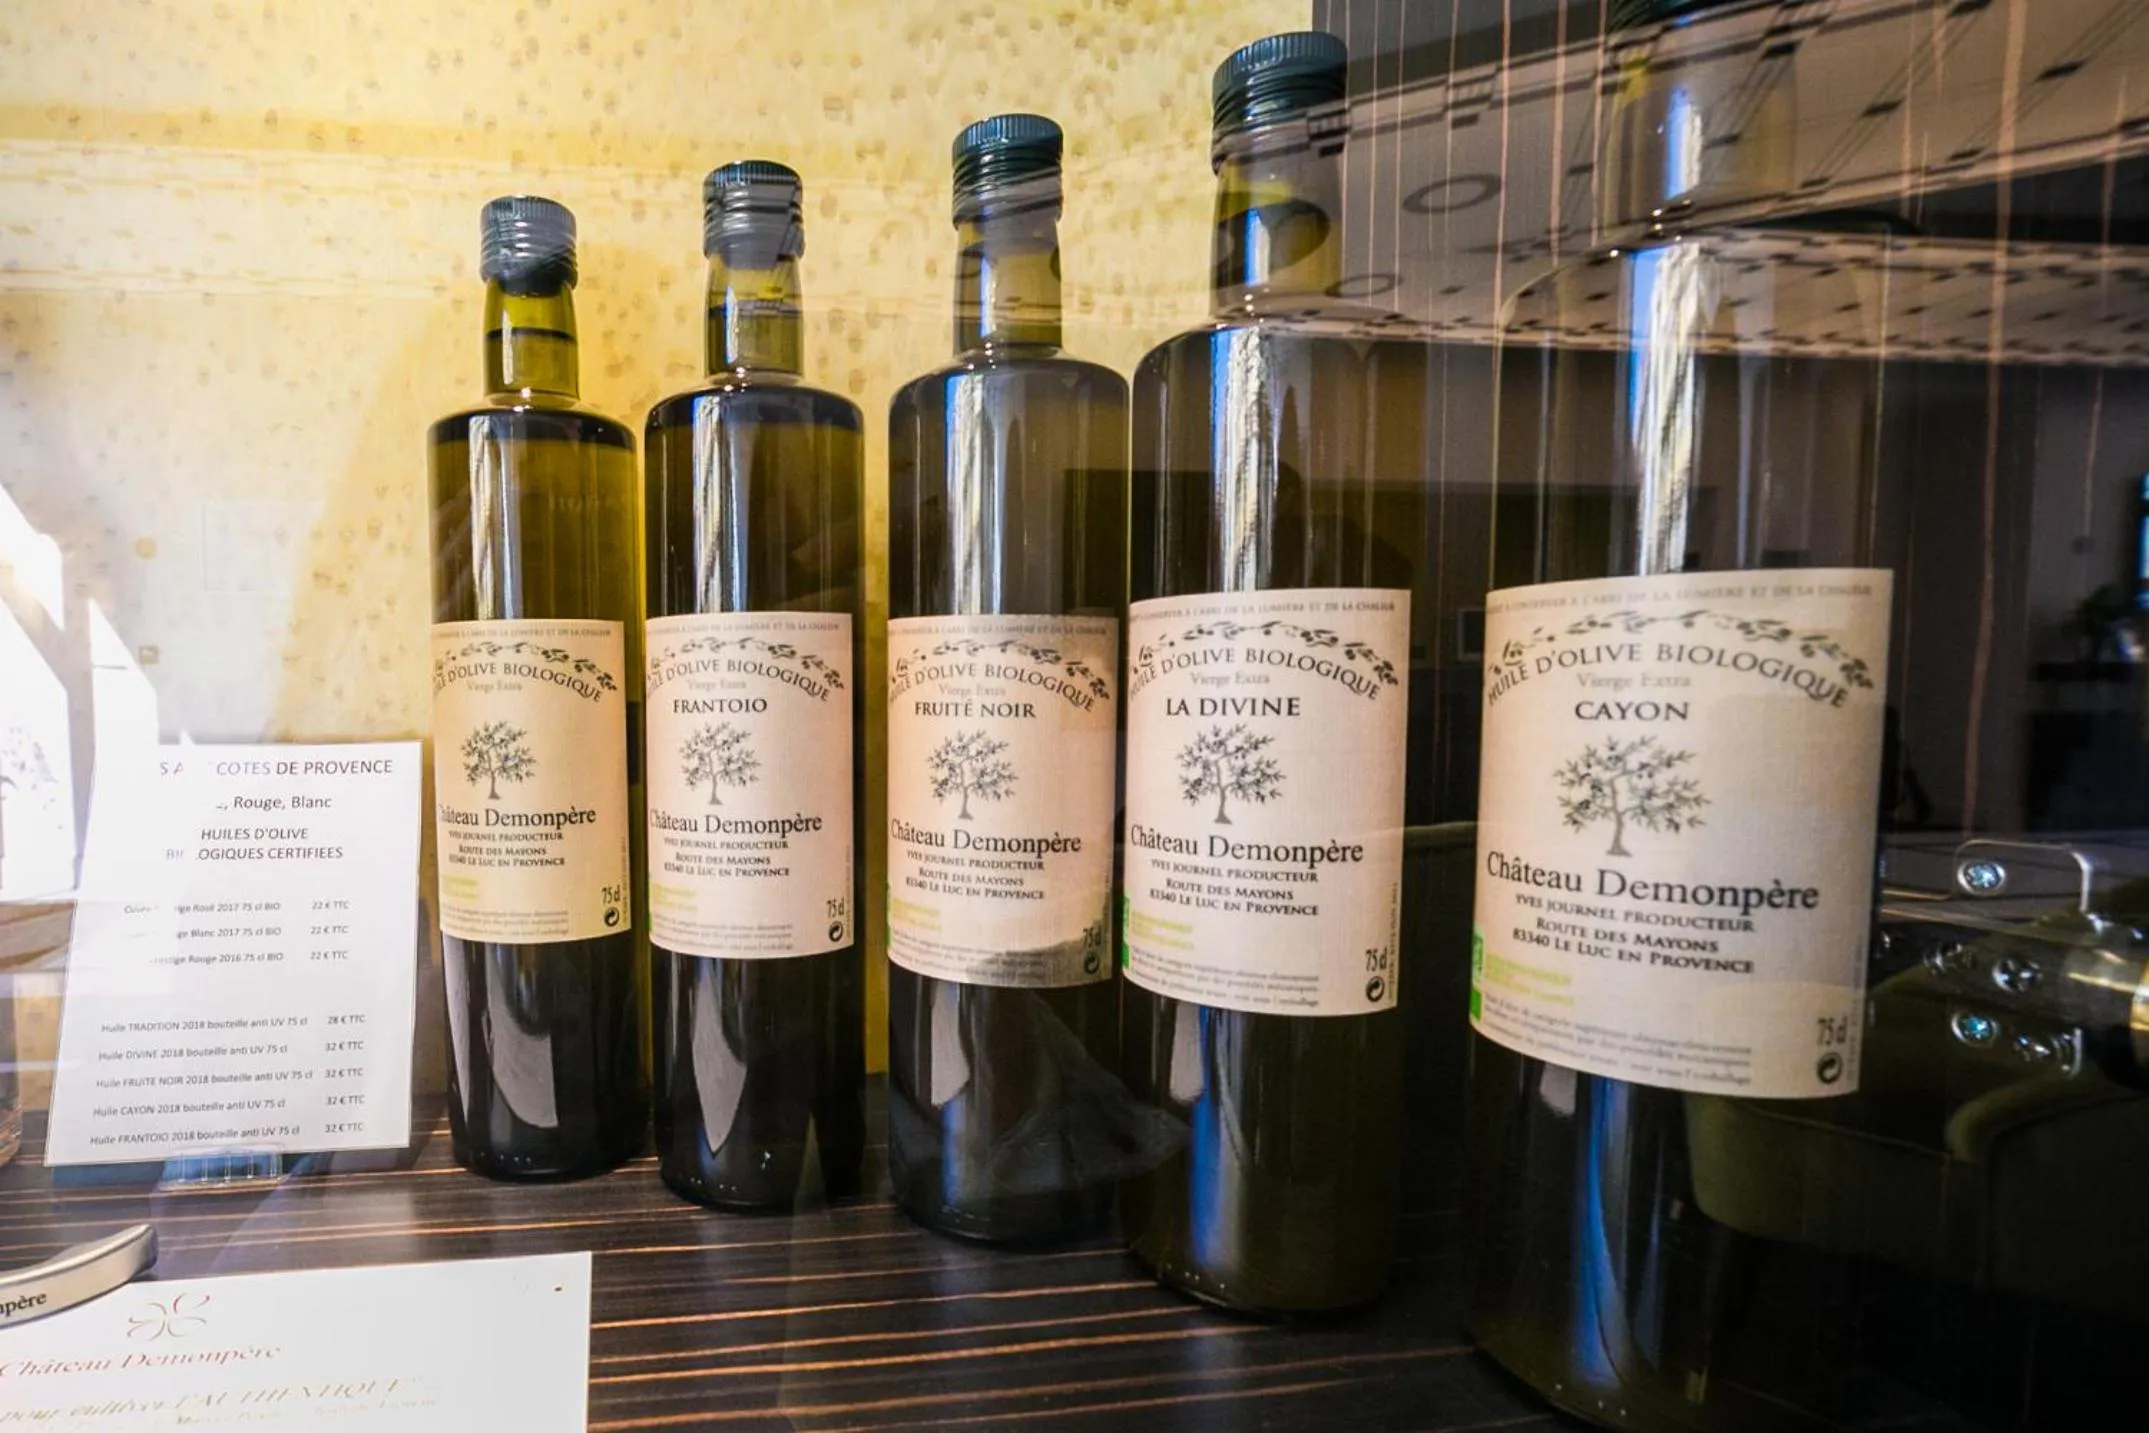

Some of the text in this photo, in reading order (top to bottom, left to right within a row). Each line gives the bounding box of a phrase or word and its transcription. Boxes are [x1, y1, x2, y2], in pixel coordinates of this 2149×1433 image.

[503, 663, 603, 702] BIOLOGIQUE
[727, 659, 831, 702] BIOLOGIQUE
[1161, 648, 1235, 674] D'OLIVE
[1245, 648, 1381, 700] BIOLOGIQUE
[1536, 643, 1642, 675] D'OLIVE
[1656, 643, 1850, 709] BIOLOGIQUE
[984, 663, 1095, 713] BIOLOGIQUE
[673, 698, 768, 714] FRANTOIO
[915, 699, 1036, 718] FRUITÉ NOIR
[1166, 696, 1301, 716] LA DIVINE
[1574, 700, 1690, 721] CAYON
[216, 760, 393, 776] COTES DE PROVENCE
[233, 795, 286, 811] Rouge,
[291, 795, 332, 808] Blanc
[485, 806, 597, 830] Demonpère
[705, 812, 823, 839] Demonpère
[201, 827, 309, 841] HUILES D'OLIVE
[891, 819, 1081, 859] Château Demonpère
[267, 846, 343, 859] CERTIFIEES
[1131, 824, 1364, 869] Château Demonpère
[513, 858, 565, 866] PROVENCE
[727, 856, 771, 865] MAYONS
[968, 858, 1045, 871] PRODUCTEUR
[735, 866, 790, 877] PROVENCE
[975, 876, 1024, 886] MAYONS
[1173, 862, 1222, 878] JOURNEL
[1227, 868, 1319, 882] PRODUCTEUR
[984, 887, 1045, 899] PROVENCE
[1166, 877, 1294, 900] ROUTE DES MAYONS
[1487, 851, 1819, 917] Château Demonpère
[1180, 893, 1319, 916] LE LUC EN PROVENCE
[1515, 893, 1756, 932] YVES JOURNEL PRODUCTEUR
[1536, 918, 1720, 954] ROUTE DES MAYONS
[1513, 928, 1755, 974] 83340 LE LUC EN PROVENCE
[128, 1021, 179, 1032] TRADITION
[207, 1019, 248, 1030] bouteille
[160, 1048, 184, 1058] 2018
[186, 1046, 227, 1057] bouteille
[211, 1072, 253, 1084] bouteille
[157, 1104, 181, 1114] 2018
[183, 1101, 224, 1113] bouteille
[118, 1132, 169, 1144] FRANTOIO
[171, 1131, 195, 1142] 2018
[197, 1129, 239, 1141] bouteille
